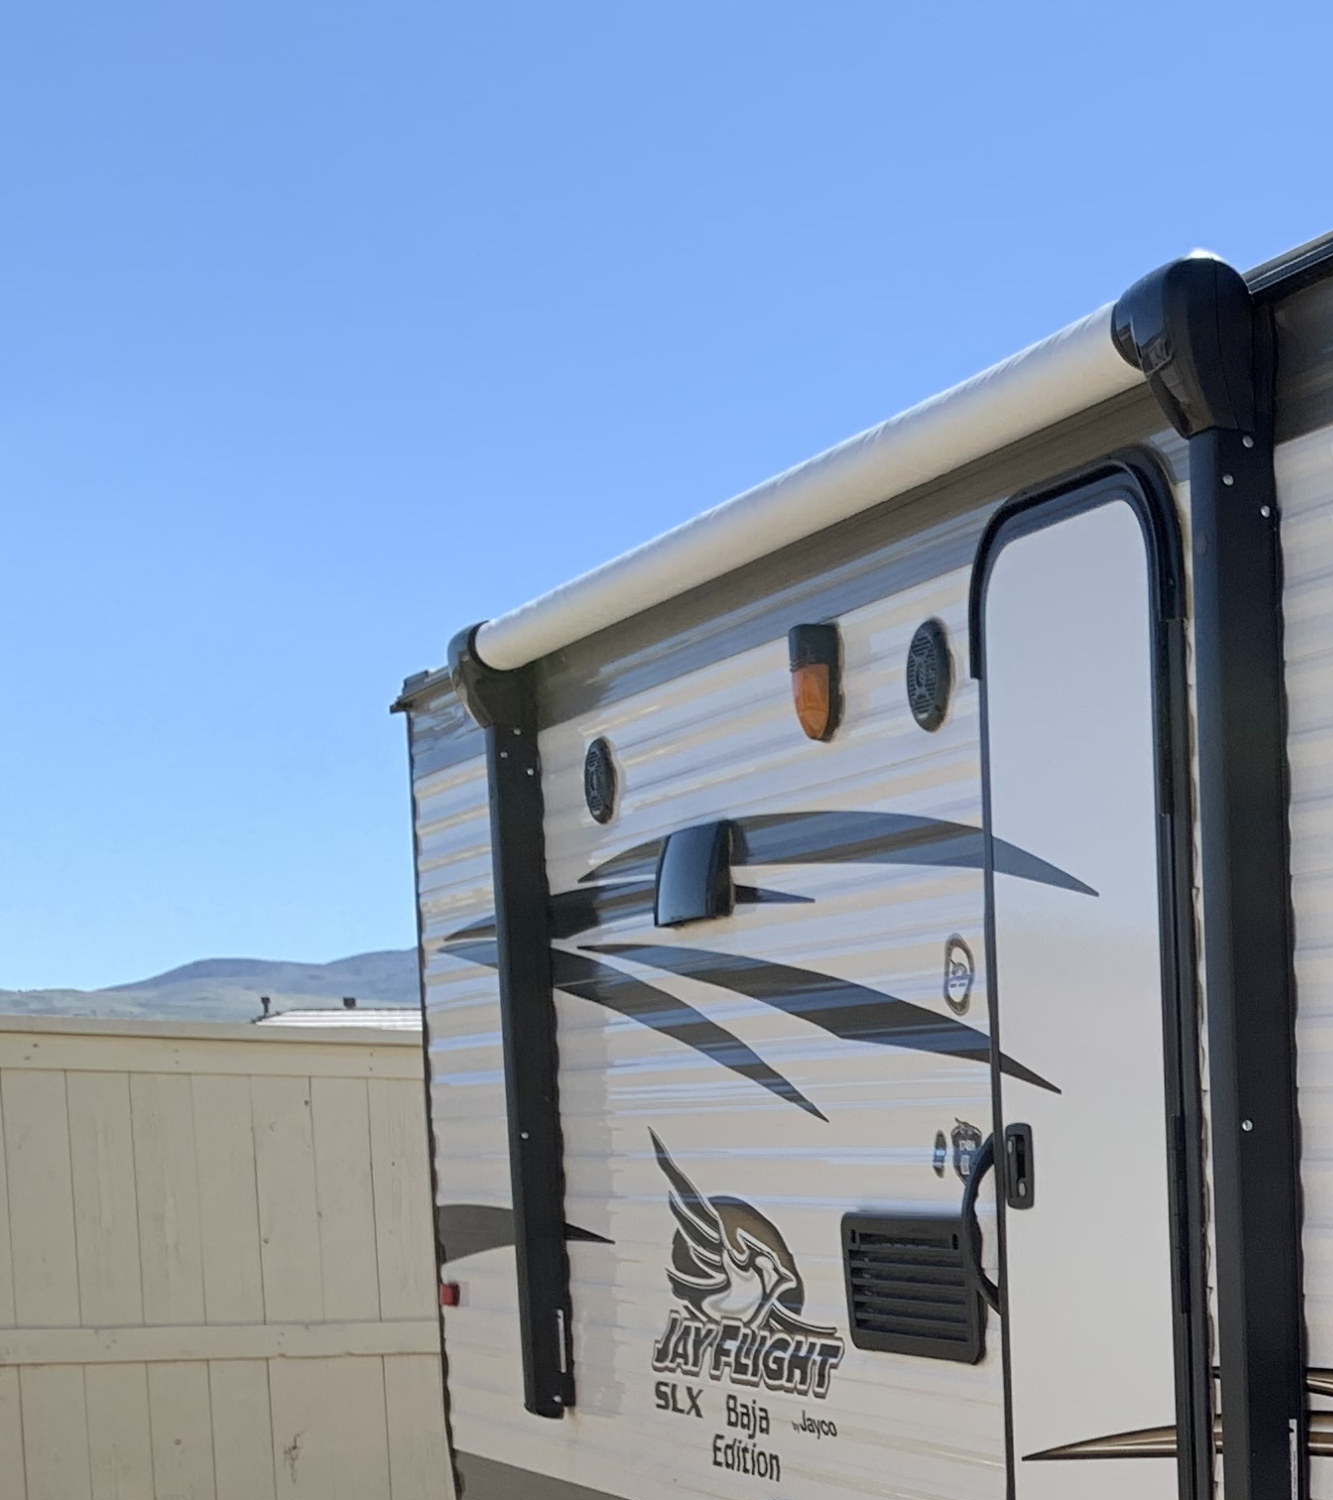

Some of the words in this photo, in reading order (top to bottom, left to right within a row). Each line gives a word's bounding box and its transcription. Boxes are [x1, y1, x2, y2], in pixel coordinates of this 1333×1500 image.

[652, 1310, 716, 1377] JAY
[709, 1316, 846, 1400] FLIGHT
[655, 1381, 704, 1419] SLX
[726, 1394, 770, 1439] Baja
[800, 1410, 838, 1440] Jayco
[712, 1434, 781, 1483] Edition
